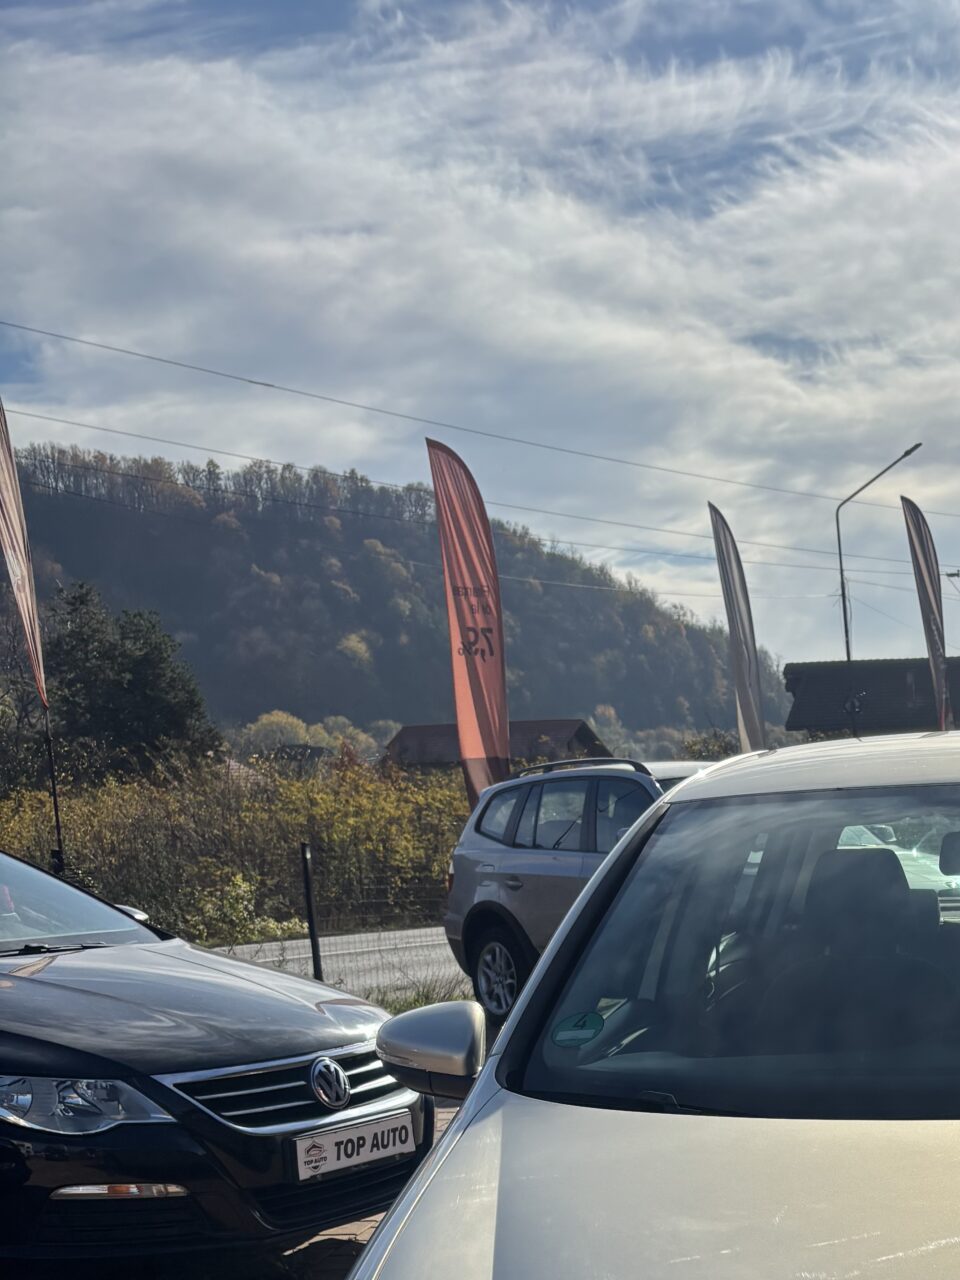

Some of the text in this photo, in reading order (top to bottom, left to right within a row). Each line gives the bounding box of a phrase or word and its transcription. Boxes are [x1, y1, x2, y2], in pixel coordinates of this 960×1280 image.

[572, 1013, 588, 1030] 4
[334, 1125, 409, 1161] TOP AUTO
